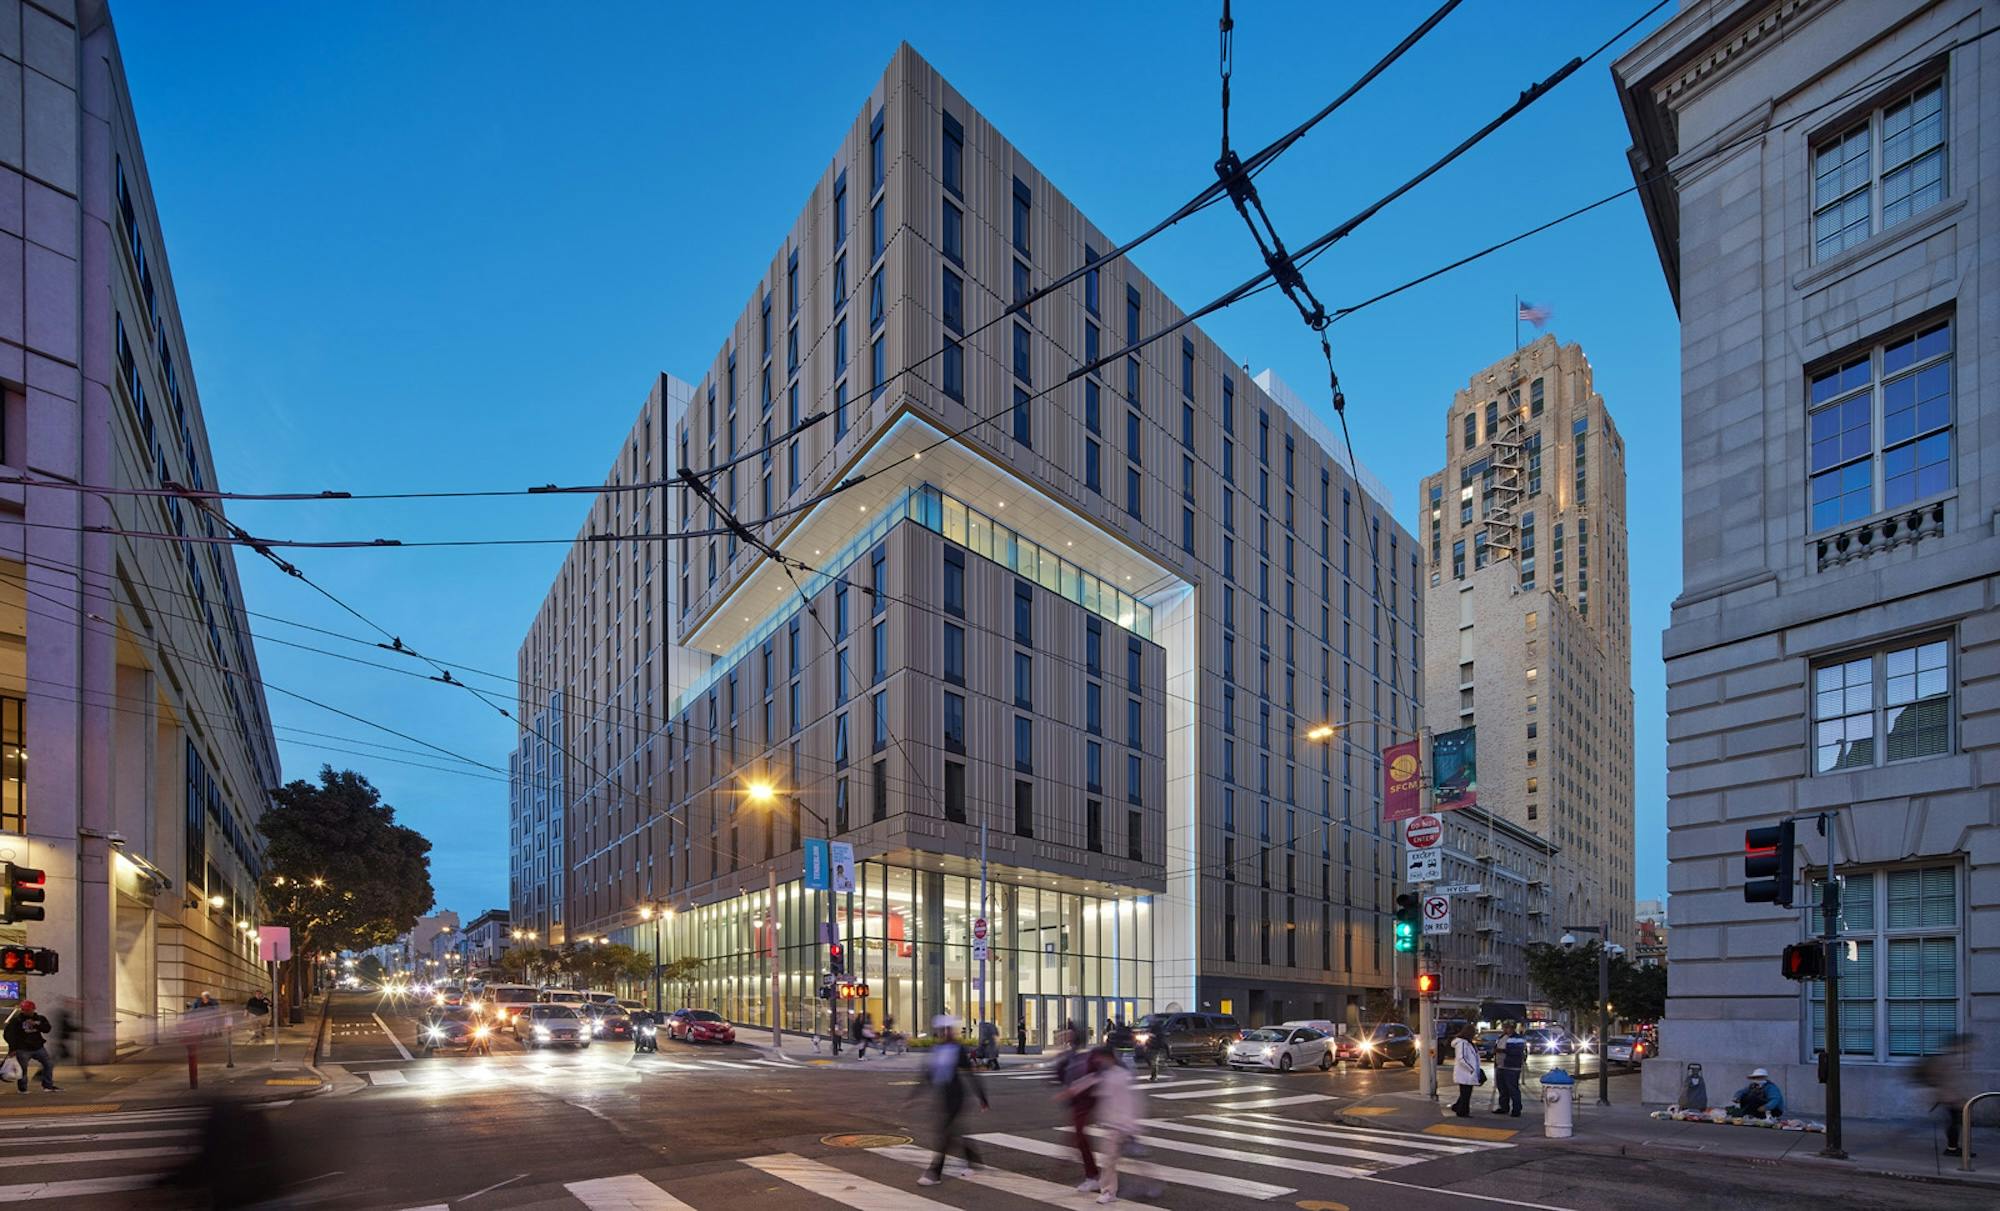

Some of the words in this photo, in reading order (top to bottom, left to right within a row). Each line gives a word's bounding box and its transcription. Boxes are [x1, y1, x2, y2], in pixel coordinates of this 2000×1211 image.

[1422, 819, 1436, 828] NOT
[1413, 836, 1435, 844] ENTER
[1412, 851, 1436, 860] EXCEPT
